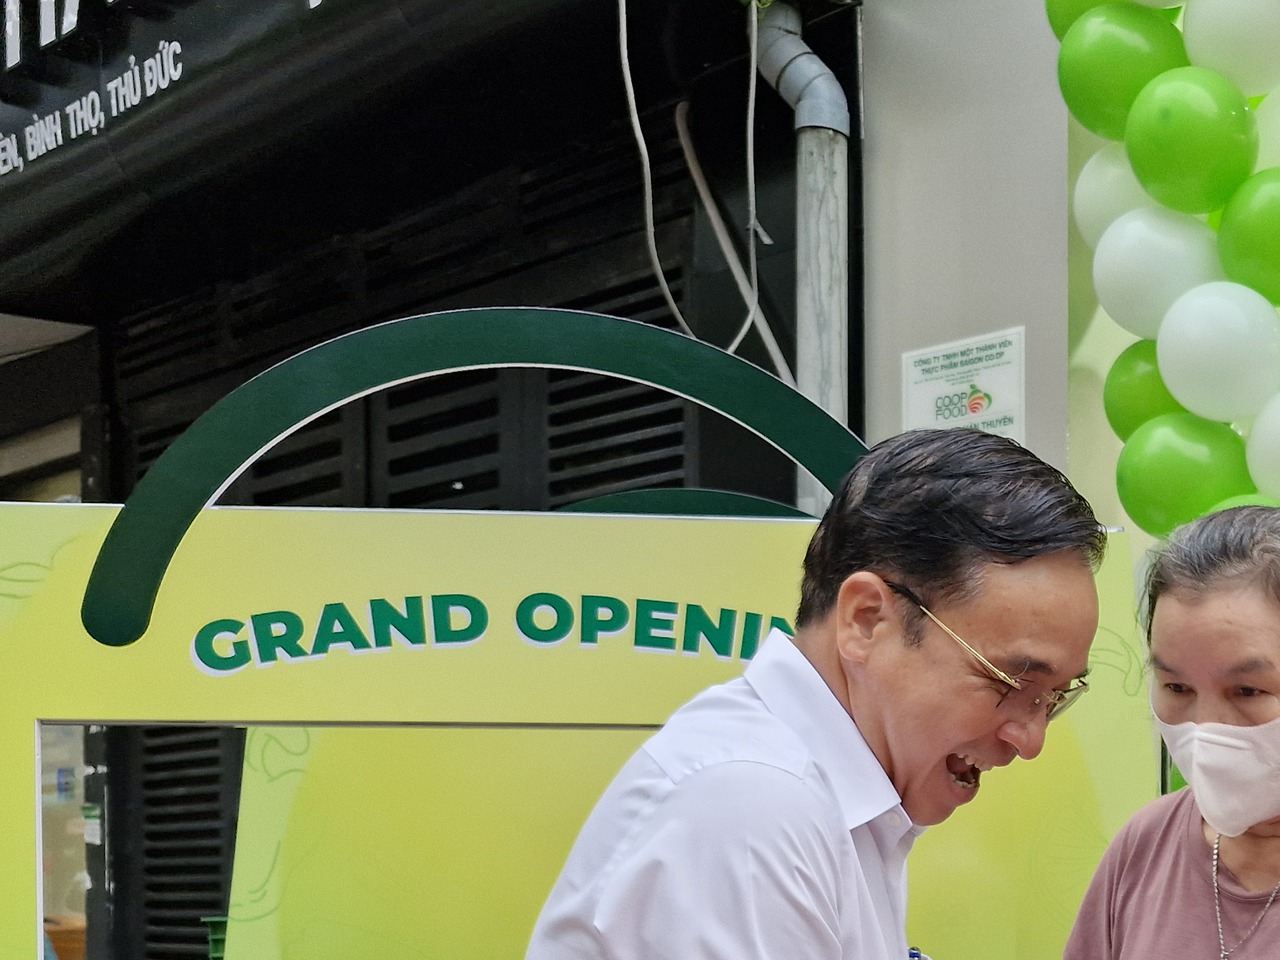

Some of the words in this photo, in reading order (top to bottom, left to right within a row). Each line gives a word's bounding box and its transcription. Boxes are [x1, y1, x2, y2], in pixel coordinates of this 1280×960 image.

[24, 113, 63, 162] BÌNH
[65, 90, 105, 139] THỌ,
[106, 55, 141, 117] THỦ
[143, 40, 183, 97] ĐỨC
[935, 392, 968, 410] COOP
[936, 405, 968, 421] FOOD
[195, 593, 489, 673] GRAND
